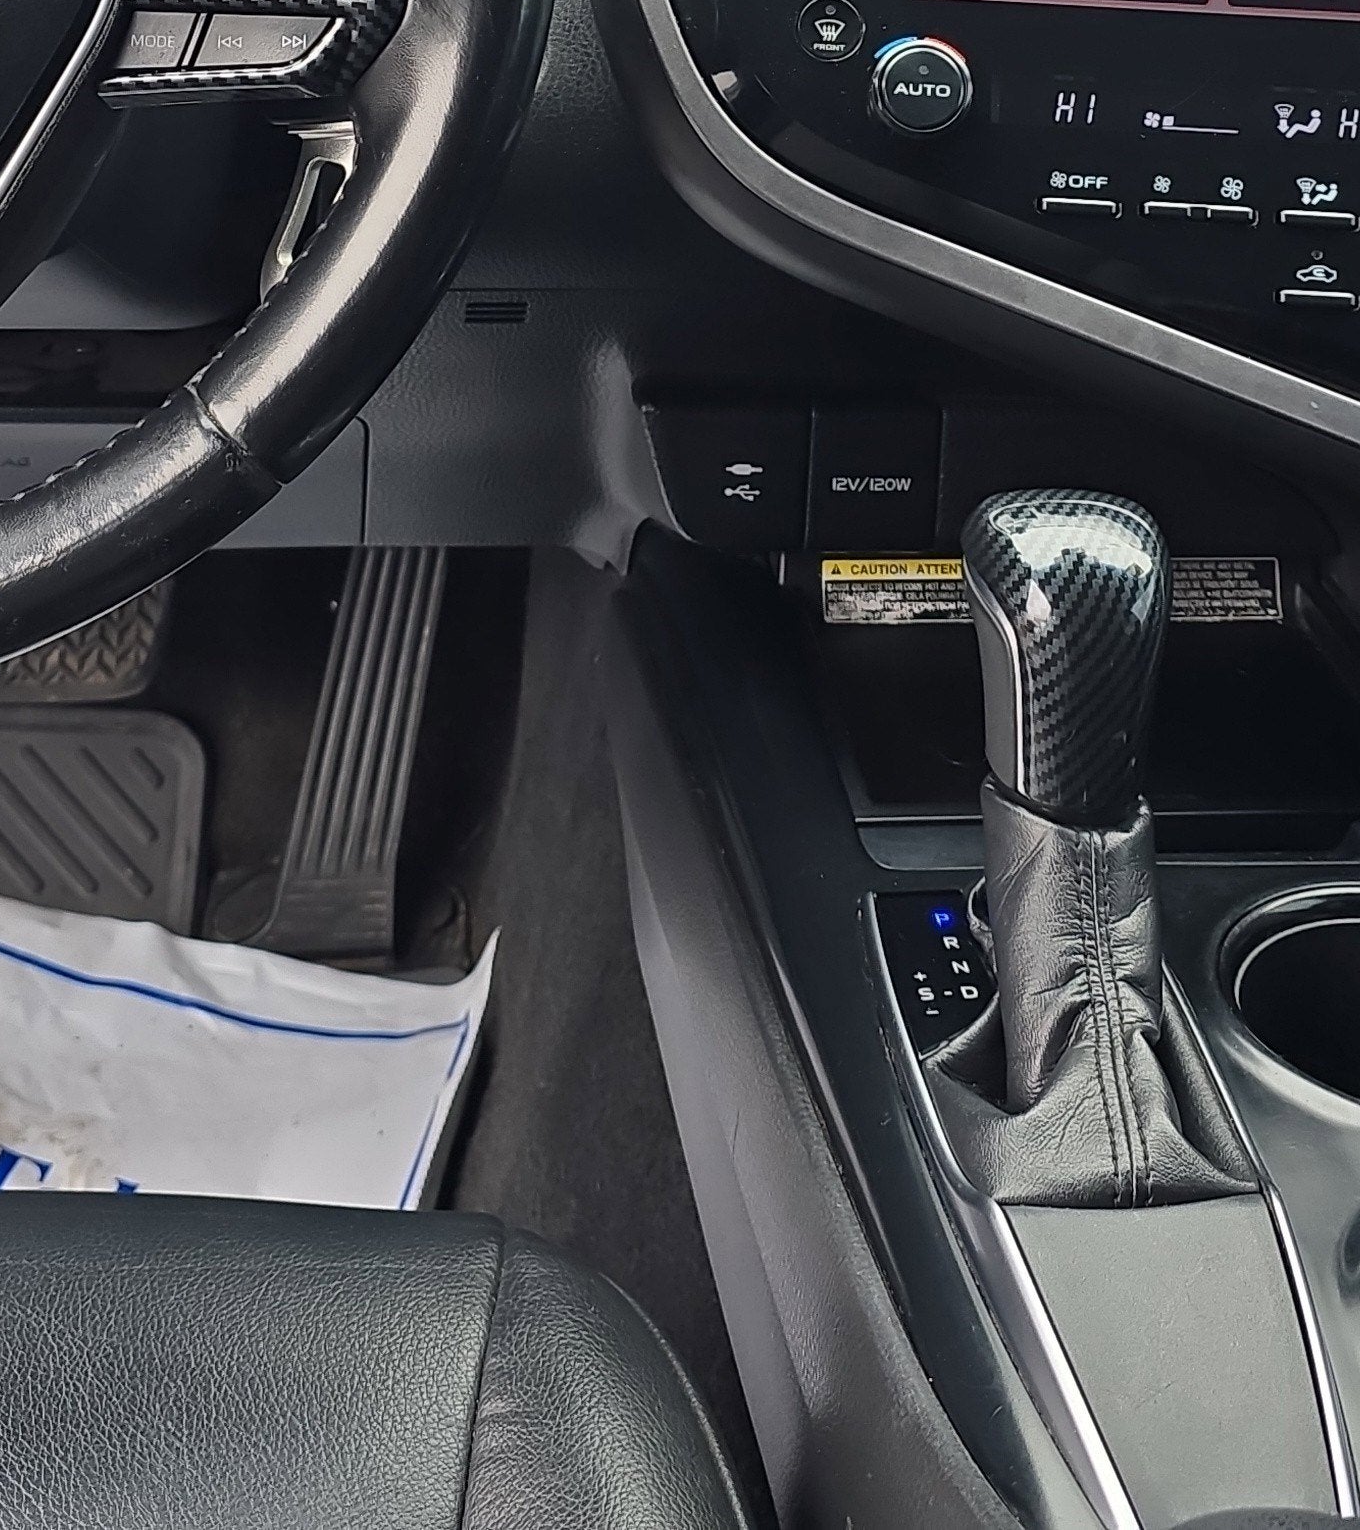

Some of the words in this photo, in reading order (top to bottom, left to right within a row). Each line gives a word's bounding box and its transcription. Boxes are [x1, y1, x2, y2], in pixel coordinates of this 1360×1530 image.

[129, 33, 176, 48] MODE
[813, 42, 847, 53] FRONT
[892, 82, 953, 99] AUTO
[1054, 92, 1097, 125] HI
[1068, 175, 1110, 190] OFF
[831, 476, 913, 494] 12V/120W
[850, 563, 909, 576] CAUTION
[933, 911, 950, 927] P
[942, 935, 961, 950] R
[951, 960, 971, 974] N
[917, 986, 935, 1002] S
[959, 985, 979, 1000] D
